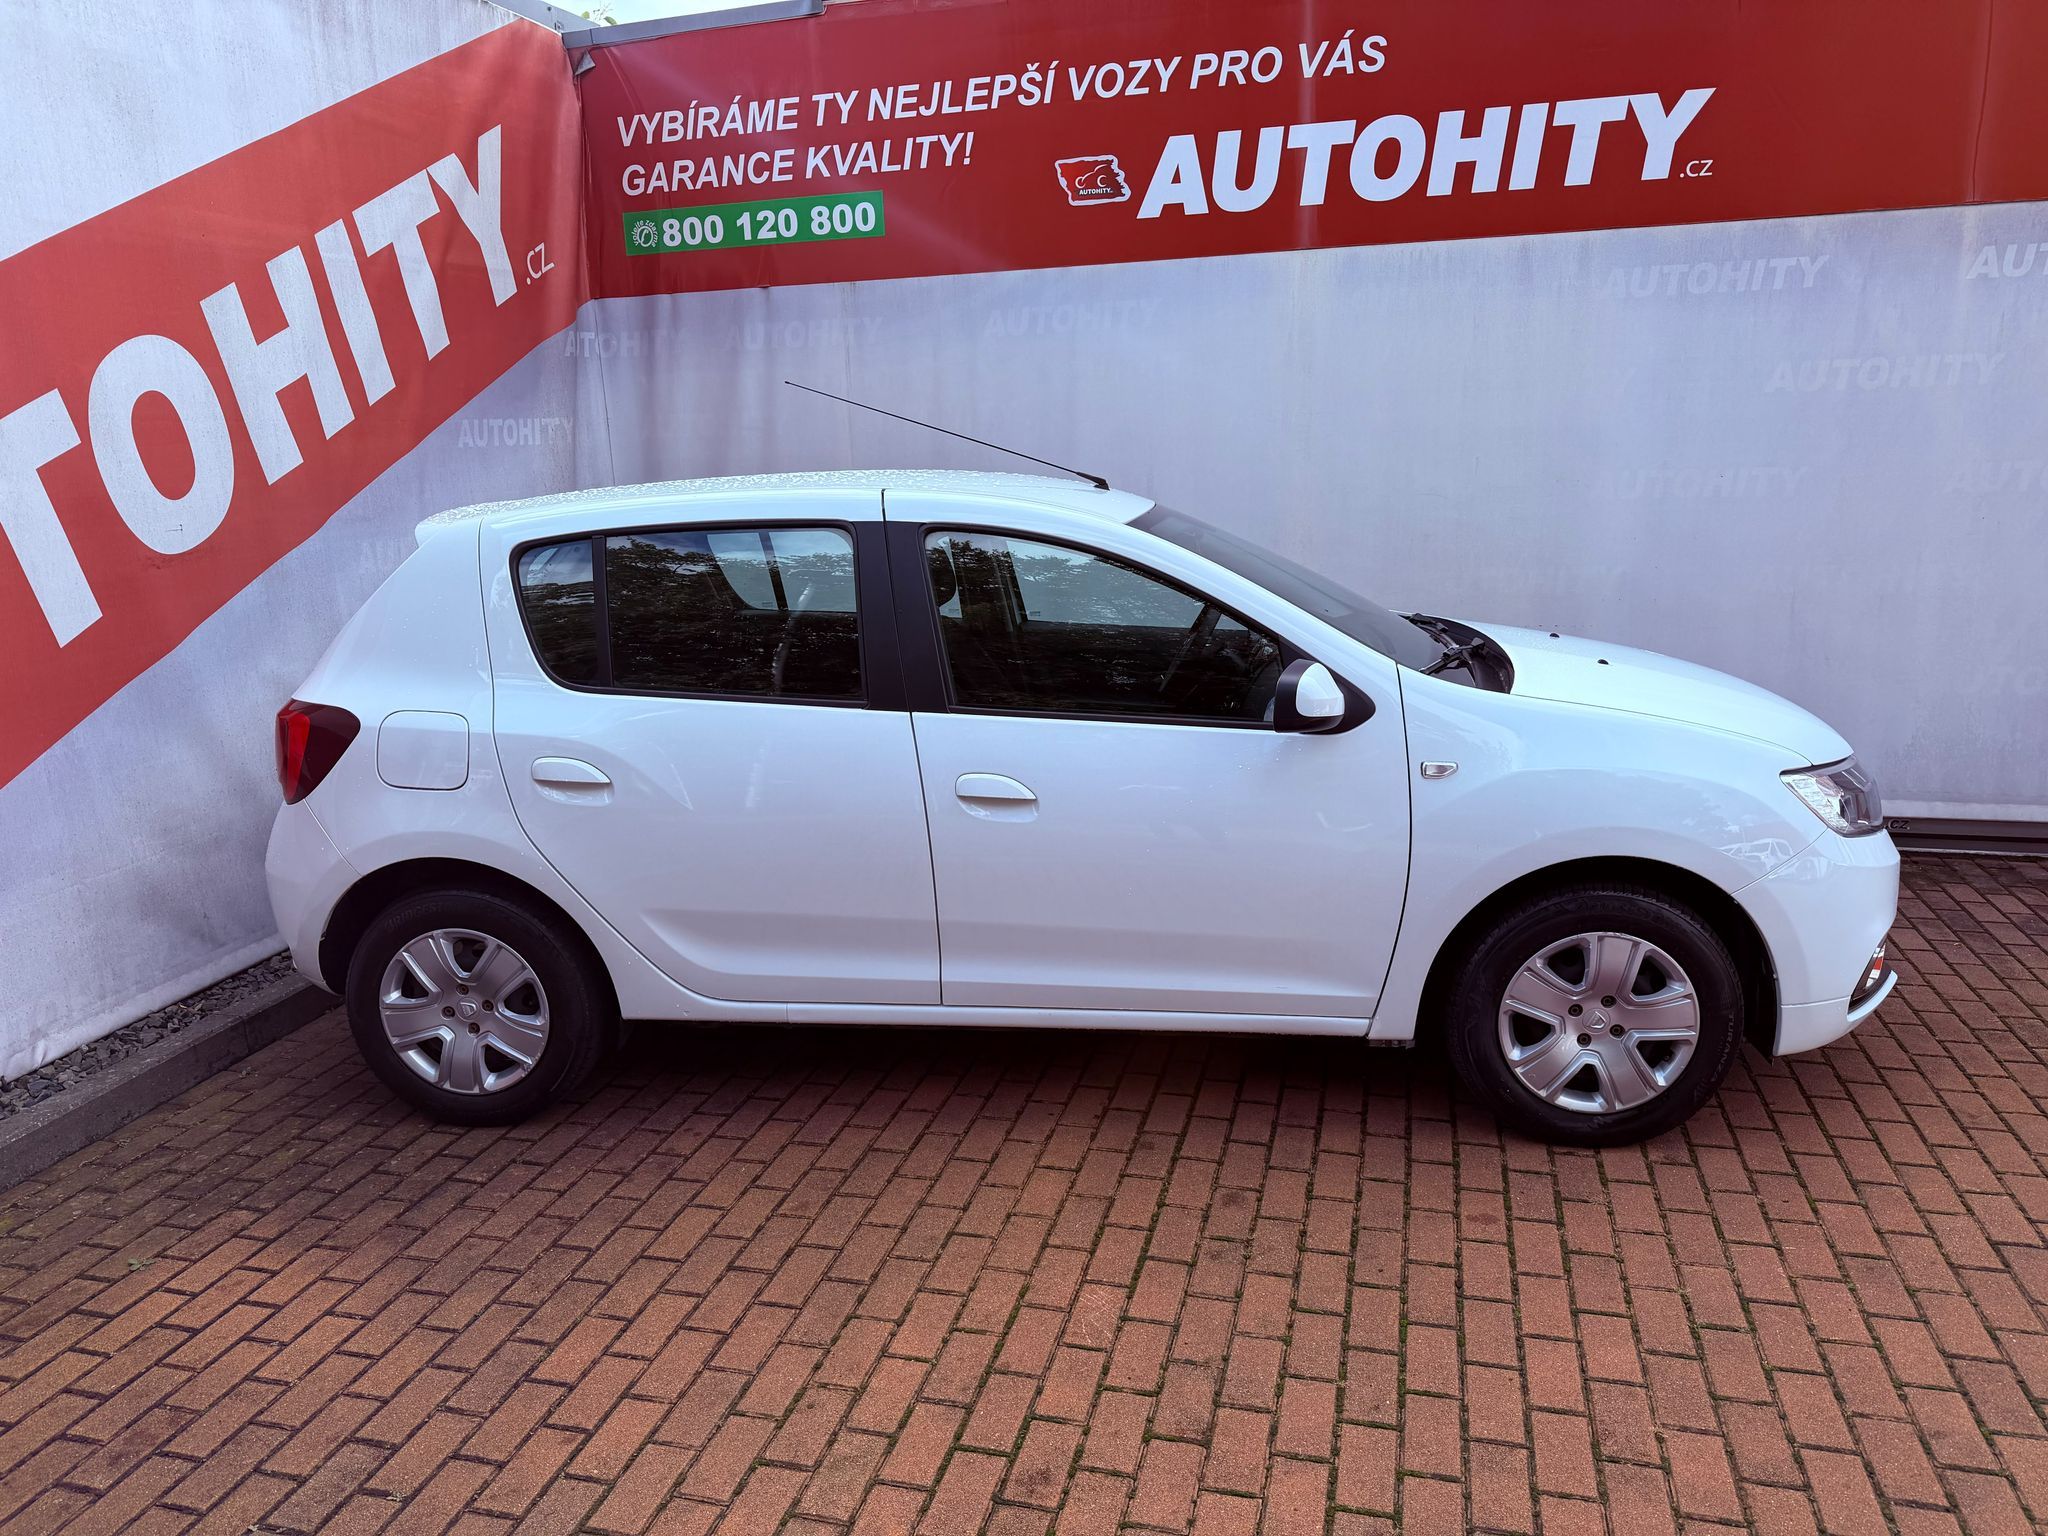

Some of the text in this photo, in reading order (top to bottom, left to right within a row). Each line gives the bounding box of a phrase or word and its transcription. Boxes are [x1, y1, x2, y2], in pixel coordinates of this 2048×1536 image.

[617, 29, 1388, 147] VYBÍRÁME TY NEJLEPŠÍ VOZY PRO VÁS
[622, 131, 975, 196] GARANCE KVALITY!
[662, 201, 876, 247] 800 120 800
[1600, 254, 1829, 298] AUTOHITY
[1965, 242, 2048, 280] AU
[1763, 352, 2006, 395] AUTOHITY
[458, 418, 572, 449] AUTOHITY
